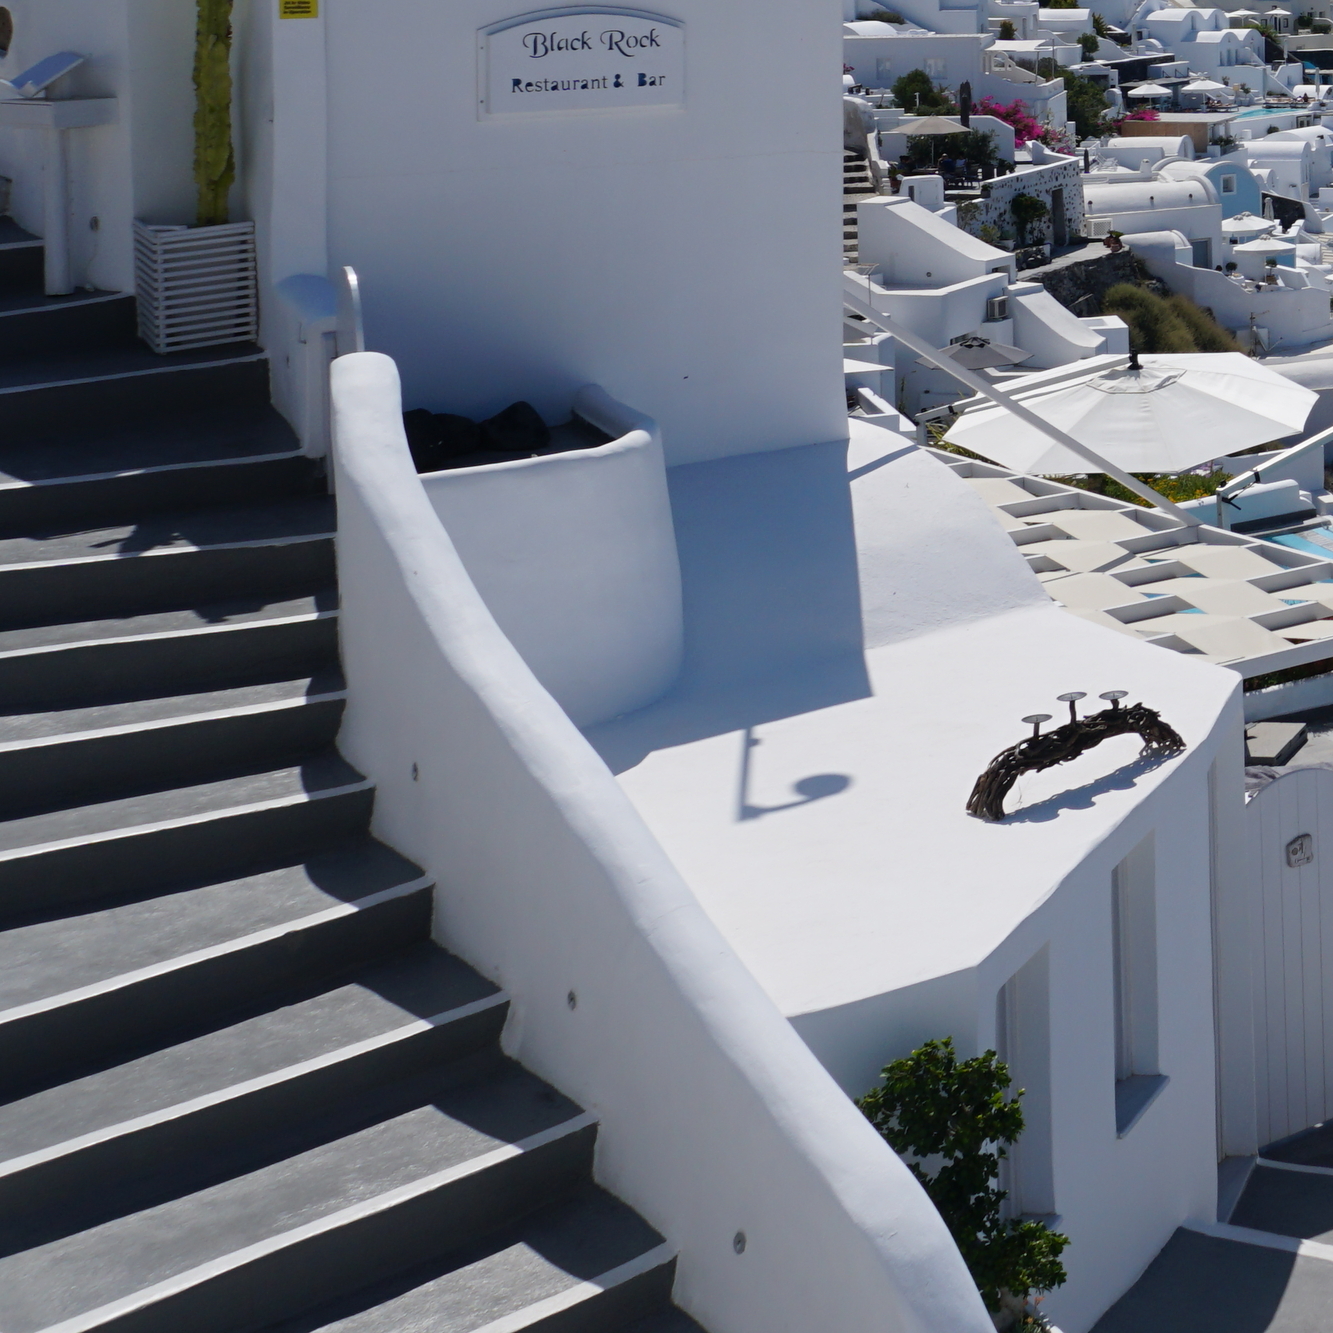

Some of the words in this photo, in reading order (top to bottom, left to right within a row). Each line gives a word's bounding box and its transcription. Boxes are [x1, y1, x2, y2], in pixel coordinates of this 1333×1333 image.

[522, 31, 592, 58] Black
[600, 28, 661, 57] Rock
[511, 75, 608, 93] Restaurant
[613, 73, 625, 88] &
[637, 72, 666, 87] Bar
